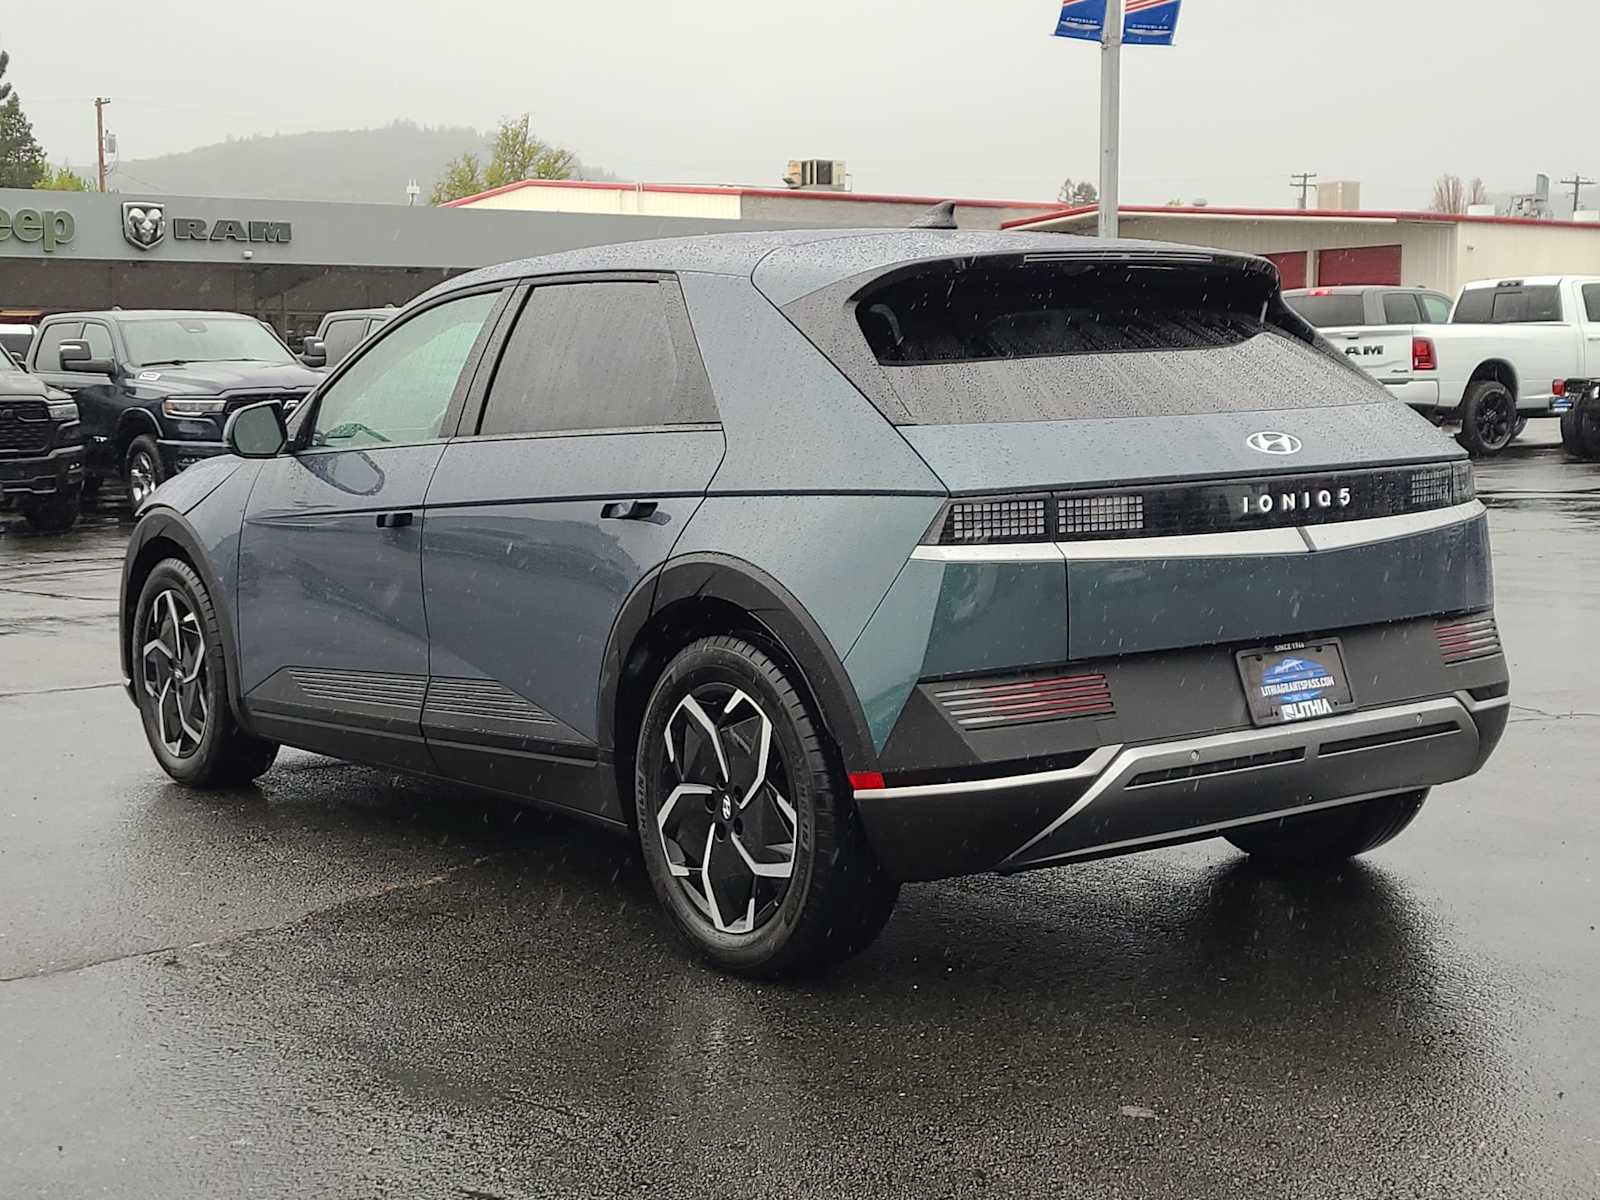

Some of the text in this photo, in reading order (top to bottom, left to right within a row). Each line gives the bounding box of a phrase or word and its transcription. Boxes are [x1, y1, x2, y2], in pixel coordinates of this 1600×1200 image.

[173, 218, 292, 243] RAM
[1345, 345, 1384, 356] AM
[1294, 698, 1333, 718] LITHIA
